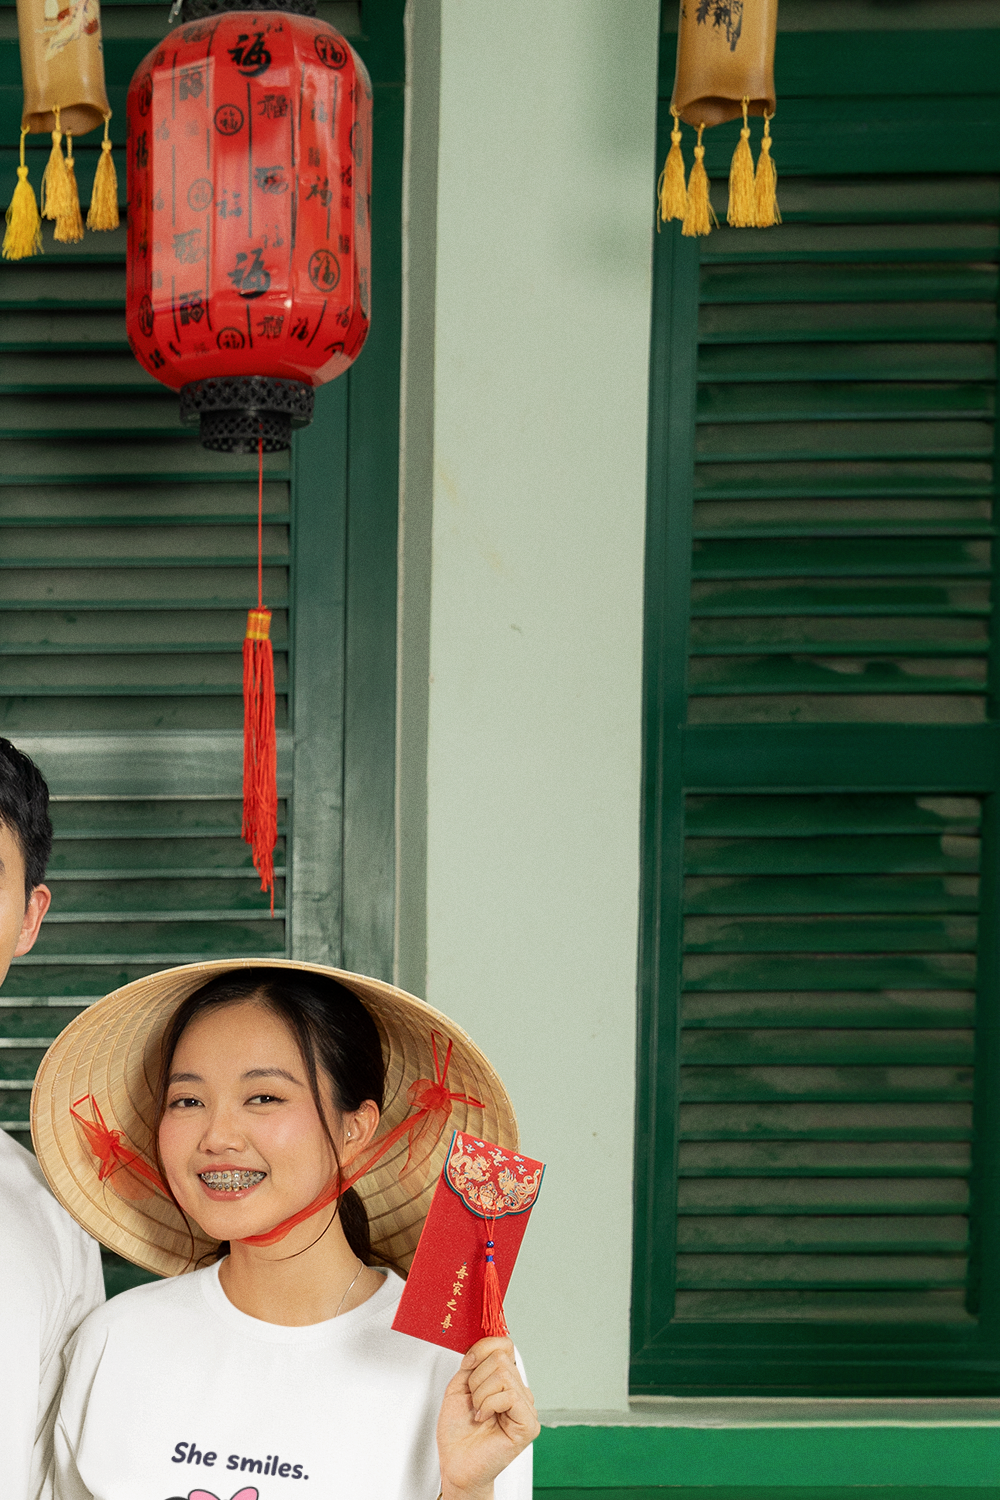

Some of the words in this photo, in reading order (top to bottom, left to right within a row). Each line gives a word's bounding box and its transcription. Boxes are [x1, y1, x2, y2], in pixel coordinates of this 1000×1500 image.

[228, 33, 271, 77] 福
[257, 94, 288, 119] 福
[227, 248, 271, 299] 福
[171, 1441, 218, 1467] She
[226, 1454, 309, 1480] smiles.
